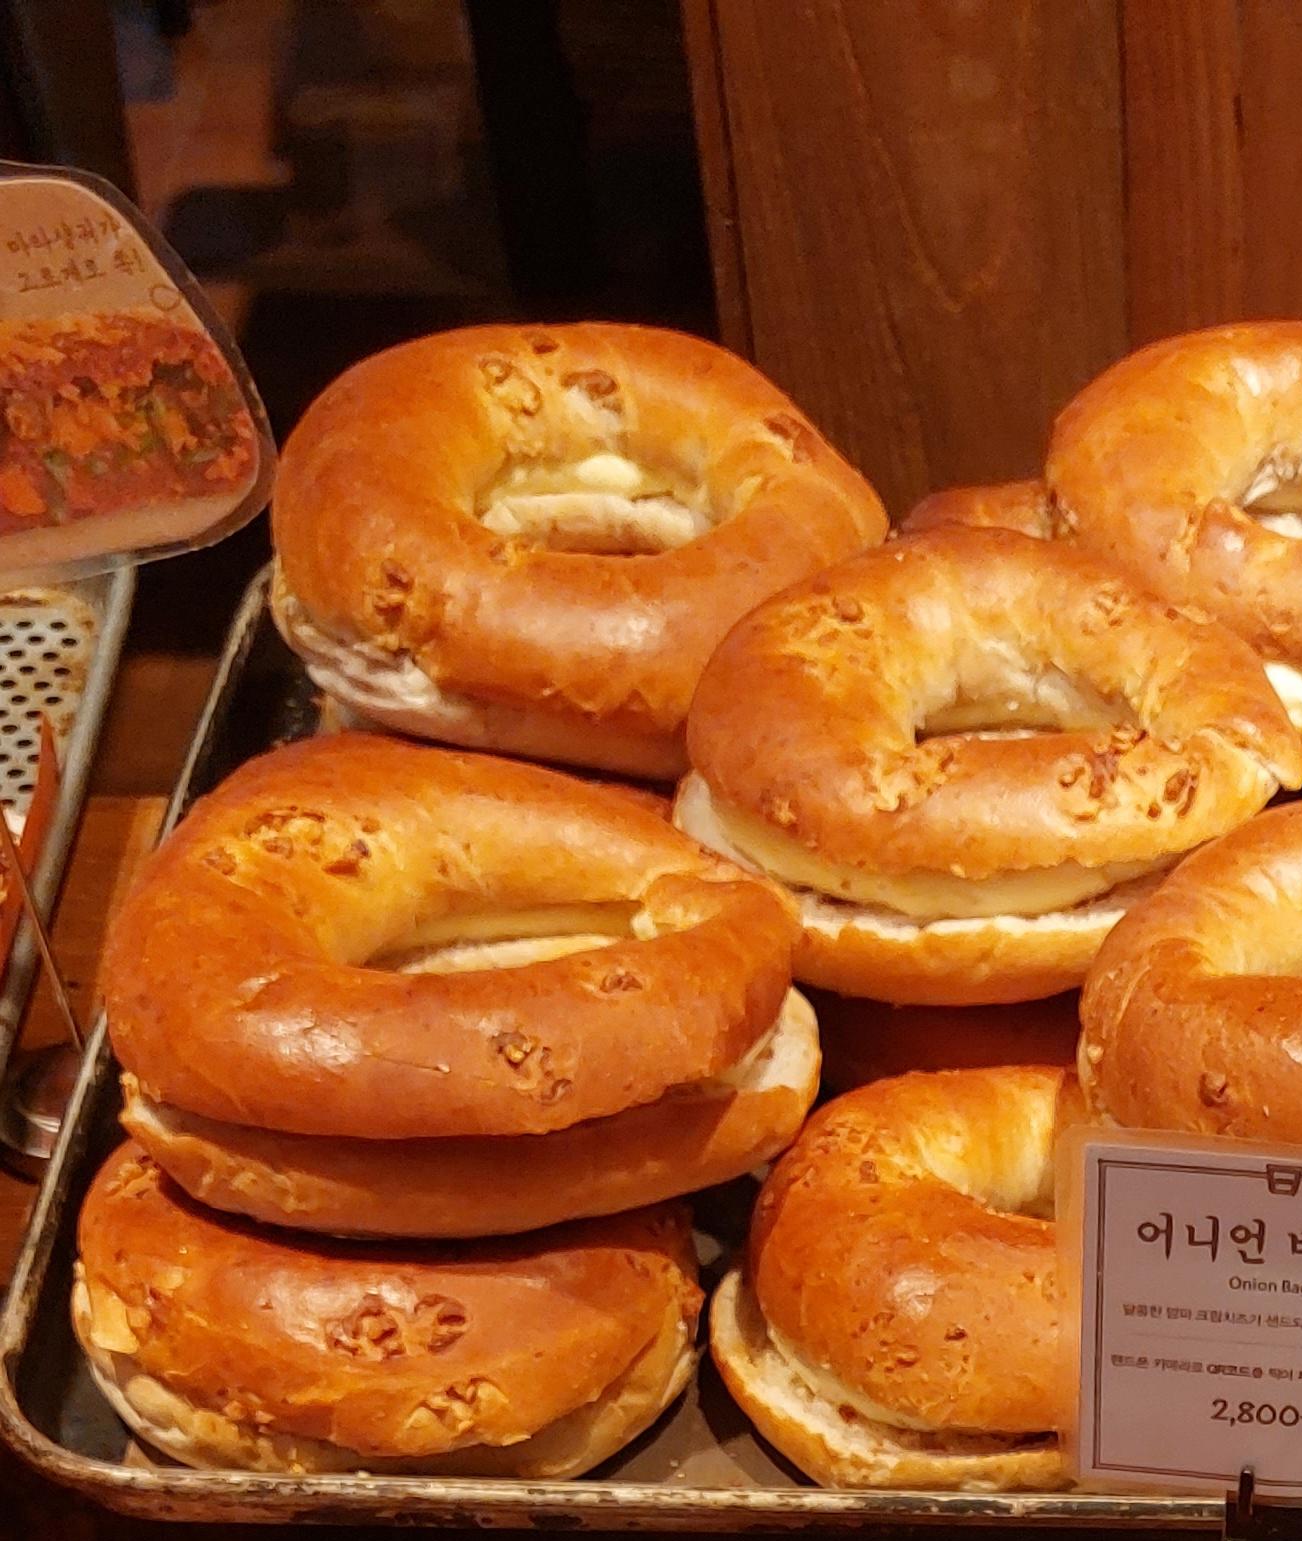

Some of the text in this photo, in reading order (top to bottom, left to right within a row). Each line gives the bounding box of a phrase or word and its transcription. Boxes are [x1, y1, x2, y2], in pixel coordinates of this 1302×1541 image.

[1137, 1212, 1267, 1265] 어니언
[1228, 1276, 1278, 1294] Onion
[1153, 1357, 1203, 1374] 카메라로
[1206, 1363, 1263, 1379] QR코드를
